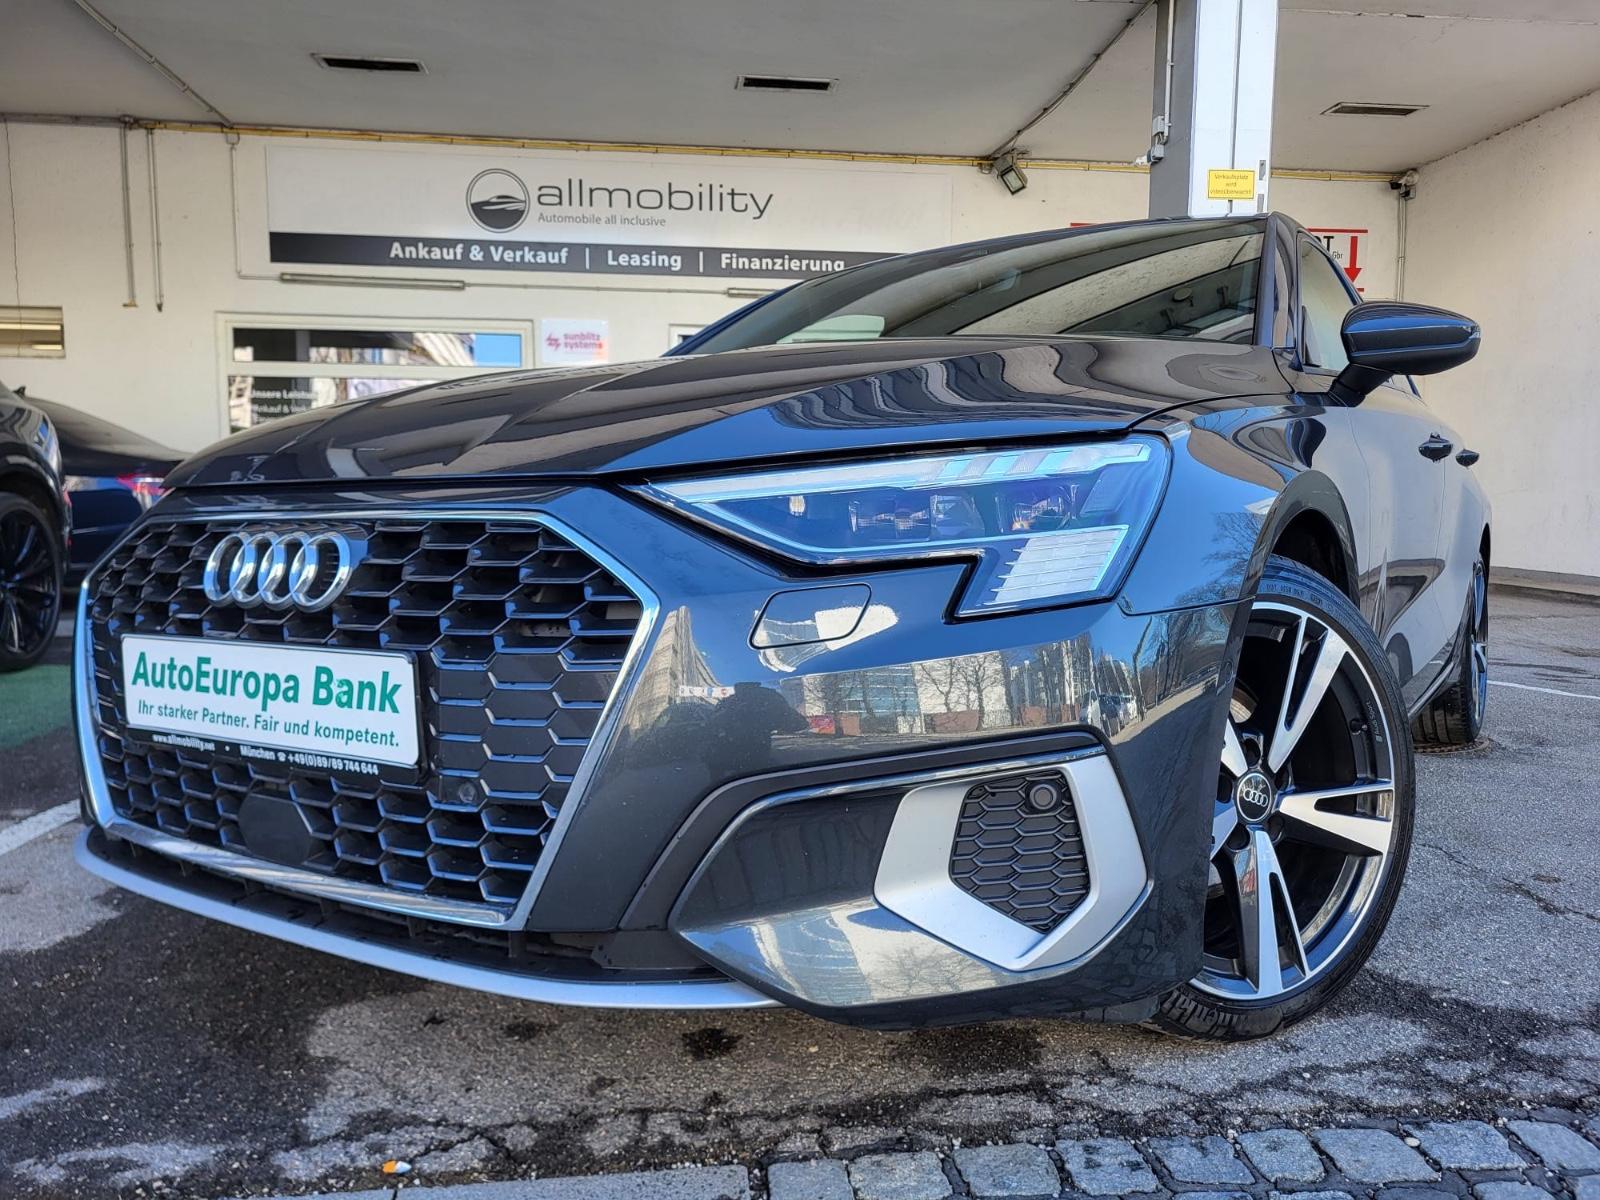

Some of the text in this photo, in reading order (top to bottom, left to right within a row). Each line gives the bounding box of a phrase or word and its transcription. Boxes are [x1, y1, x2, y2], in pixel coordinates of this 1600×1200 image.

[536, 177, 774, 221] allmobility
[537, 211, 667, 227] Automobile all inclusive
[389, 241, 846, 272] Ankauf & Verkauf Leasing Finanzierung
[131, 651, 403, 714] AutoEuropa Bank
[138, 699, 400, 748] Ihr starker Partner. Fair und kompetent.
[239, 744, 276, 761] München
